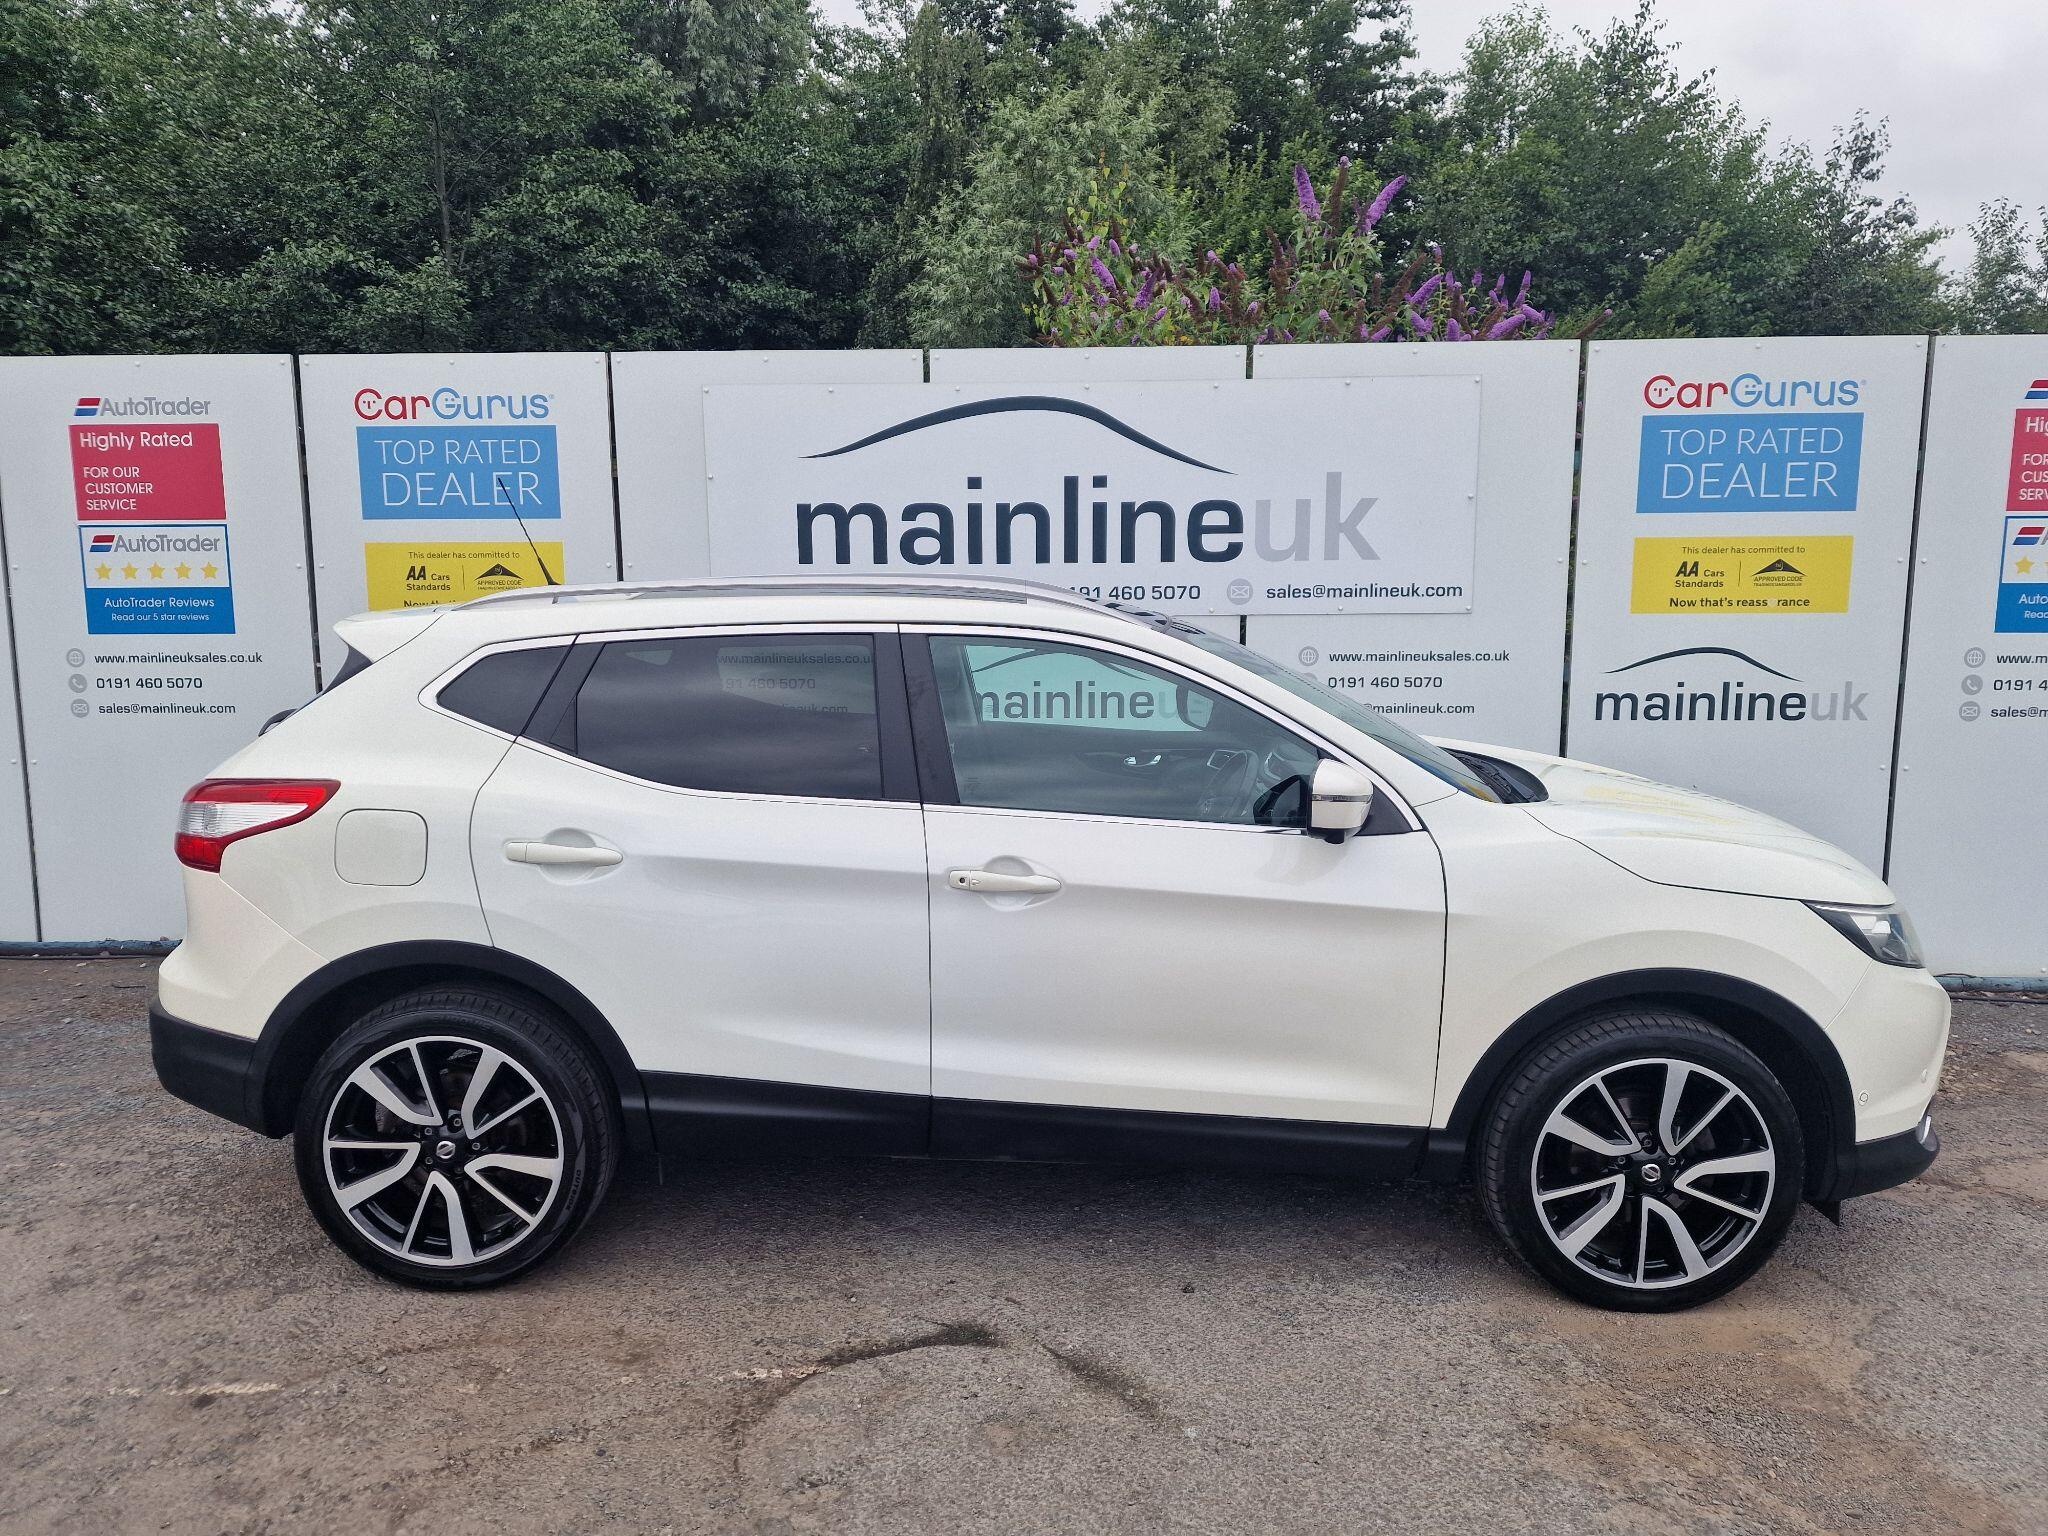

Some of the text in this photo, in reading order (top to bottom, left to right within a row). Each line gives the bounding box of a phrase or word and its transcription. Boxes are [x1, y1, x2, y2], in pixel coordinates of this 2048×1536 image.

[1644, 373, 1859, 409] CarGurus
[100, 397, 211, 416] AutoTrader
[354, 387, 550, 421] CarGurus
[79, 431, 193, 452] Highly Rated
[1660, 428, 1844, 456] TOP RATED
[373, 439, 541, 465] TOP RATED
[83, 466, 140, 479] FOR OUR
[1662, 461, 1838, 499] DEALER
[85, 483, 153, 495] CUSTOMER
[382, 472, 542, 506] DEALER
[86, 499, 137, 511] SERVICE
[797, 471, 1381, 565] mainlineuk
[113, 534, 220, 553] AutoTrader
[1681, 546, 1699, 554] This
[1702, 546, 1728, 554] dealer
[1730, 546, 1745, 554] has
[1748, 546, 1794, 554] committed
[468, 551, 510, 559] committed
[406, 566, 427, 581] AA
[1675, 561, 1725, 577] AA Cars
[406, 583, 451, 591] Standards
[1675, 580, 1724, 588] Standards
[1108, 586, 1145, 600] 460
[1152, 586, 1200, 599] 5070
[1266, 583, 1463, 599] sales@mainlineuk.com
[104, 597, 215, 608] AutoTrader Reviews
[1669, 597, 1810, 608] Now that's reassrance
[111, 612, 210, 622] Read our 5 star reviews
[94, 652, 263, 664] www.mainlineuksales.co.uk
[1329, 650, 1510, 662] www.mainlineuksales.co.uk
[96, 677, 203, 689] 0191 460 5070
[779, 678, 816, 690] 5070
[1328, 676, 1443, 689] 0191 460 5070
[1993, 679, 2033, 691] 0191
[1595, 681, 1869, 721] mainlineuk
[98, 703, 236, 714] sales@mainlineuk.com
